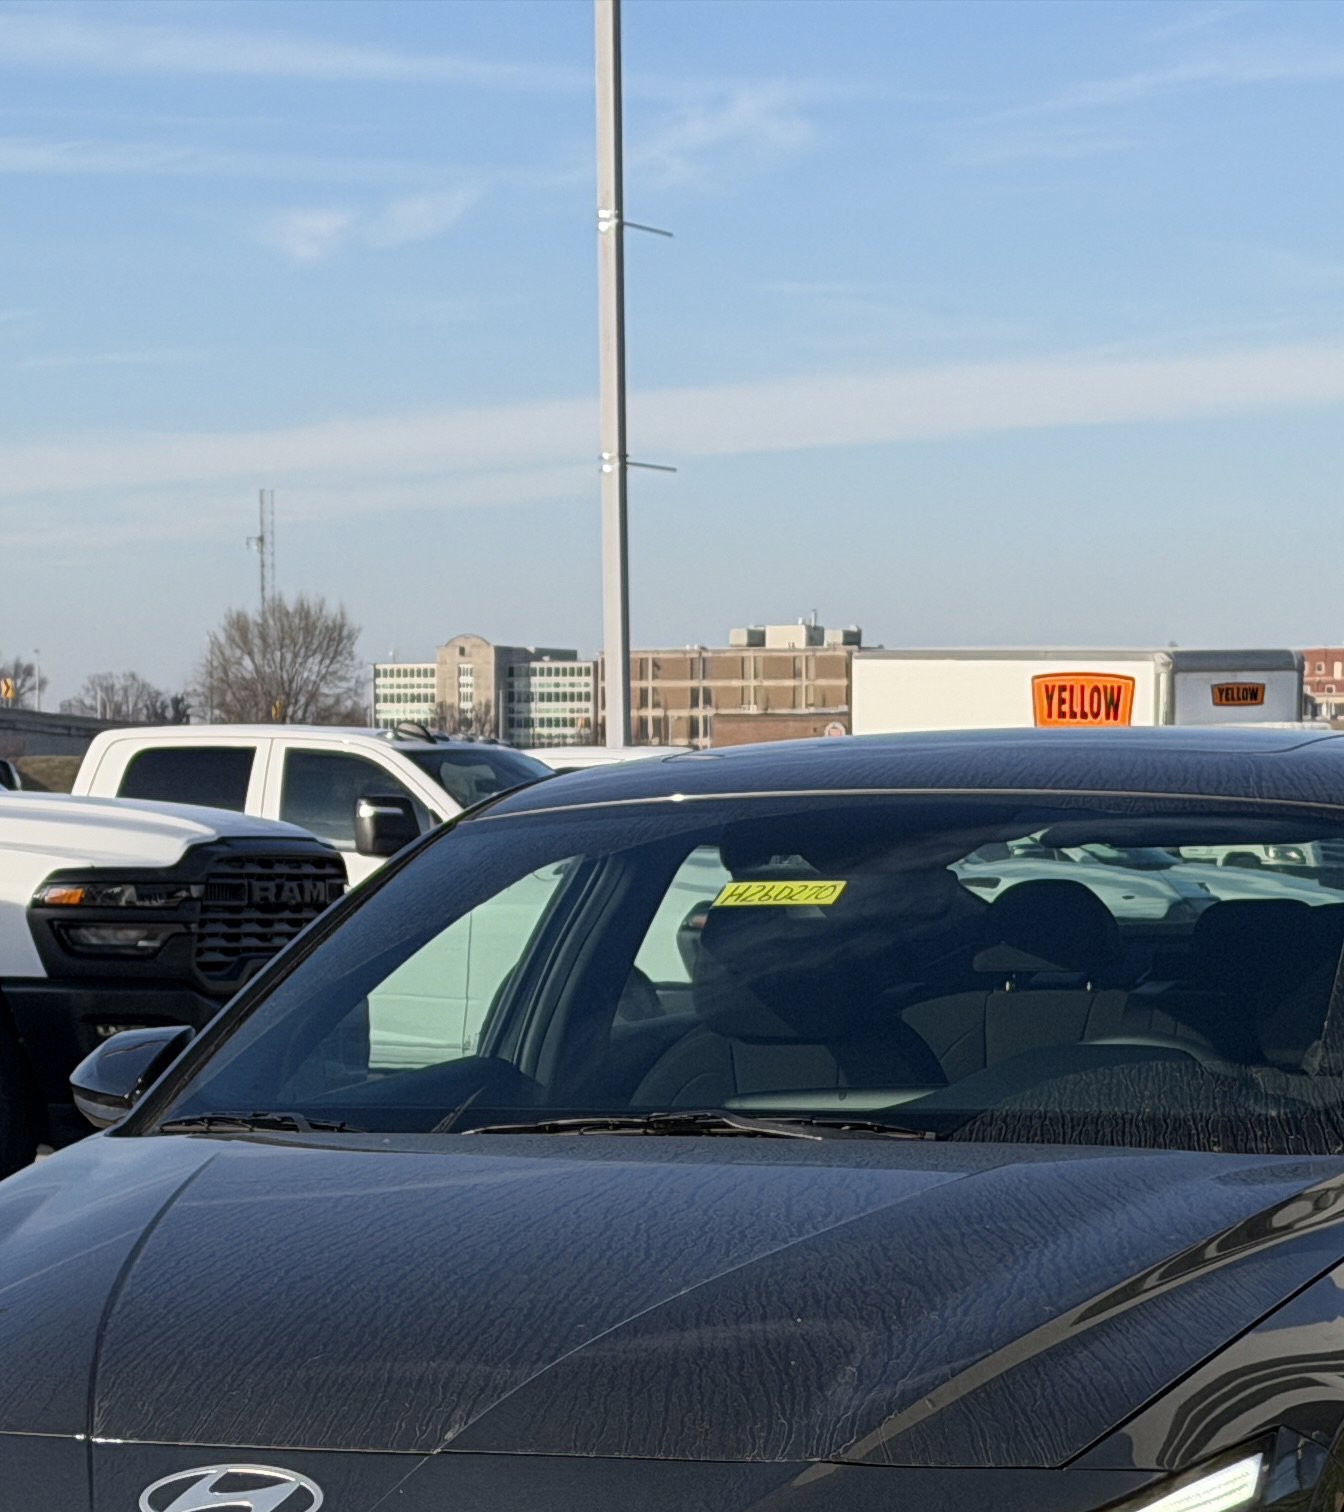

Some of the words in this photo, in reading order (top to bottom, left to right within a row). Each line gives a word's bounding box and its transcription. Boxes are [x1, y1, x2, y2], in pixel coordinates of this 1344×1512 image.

[1044, 683, 1123, 721] YELLOW
[1217, 686, 1260, 702] YELLOW
[251, 880, 326, 905] RAM
